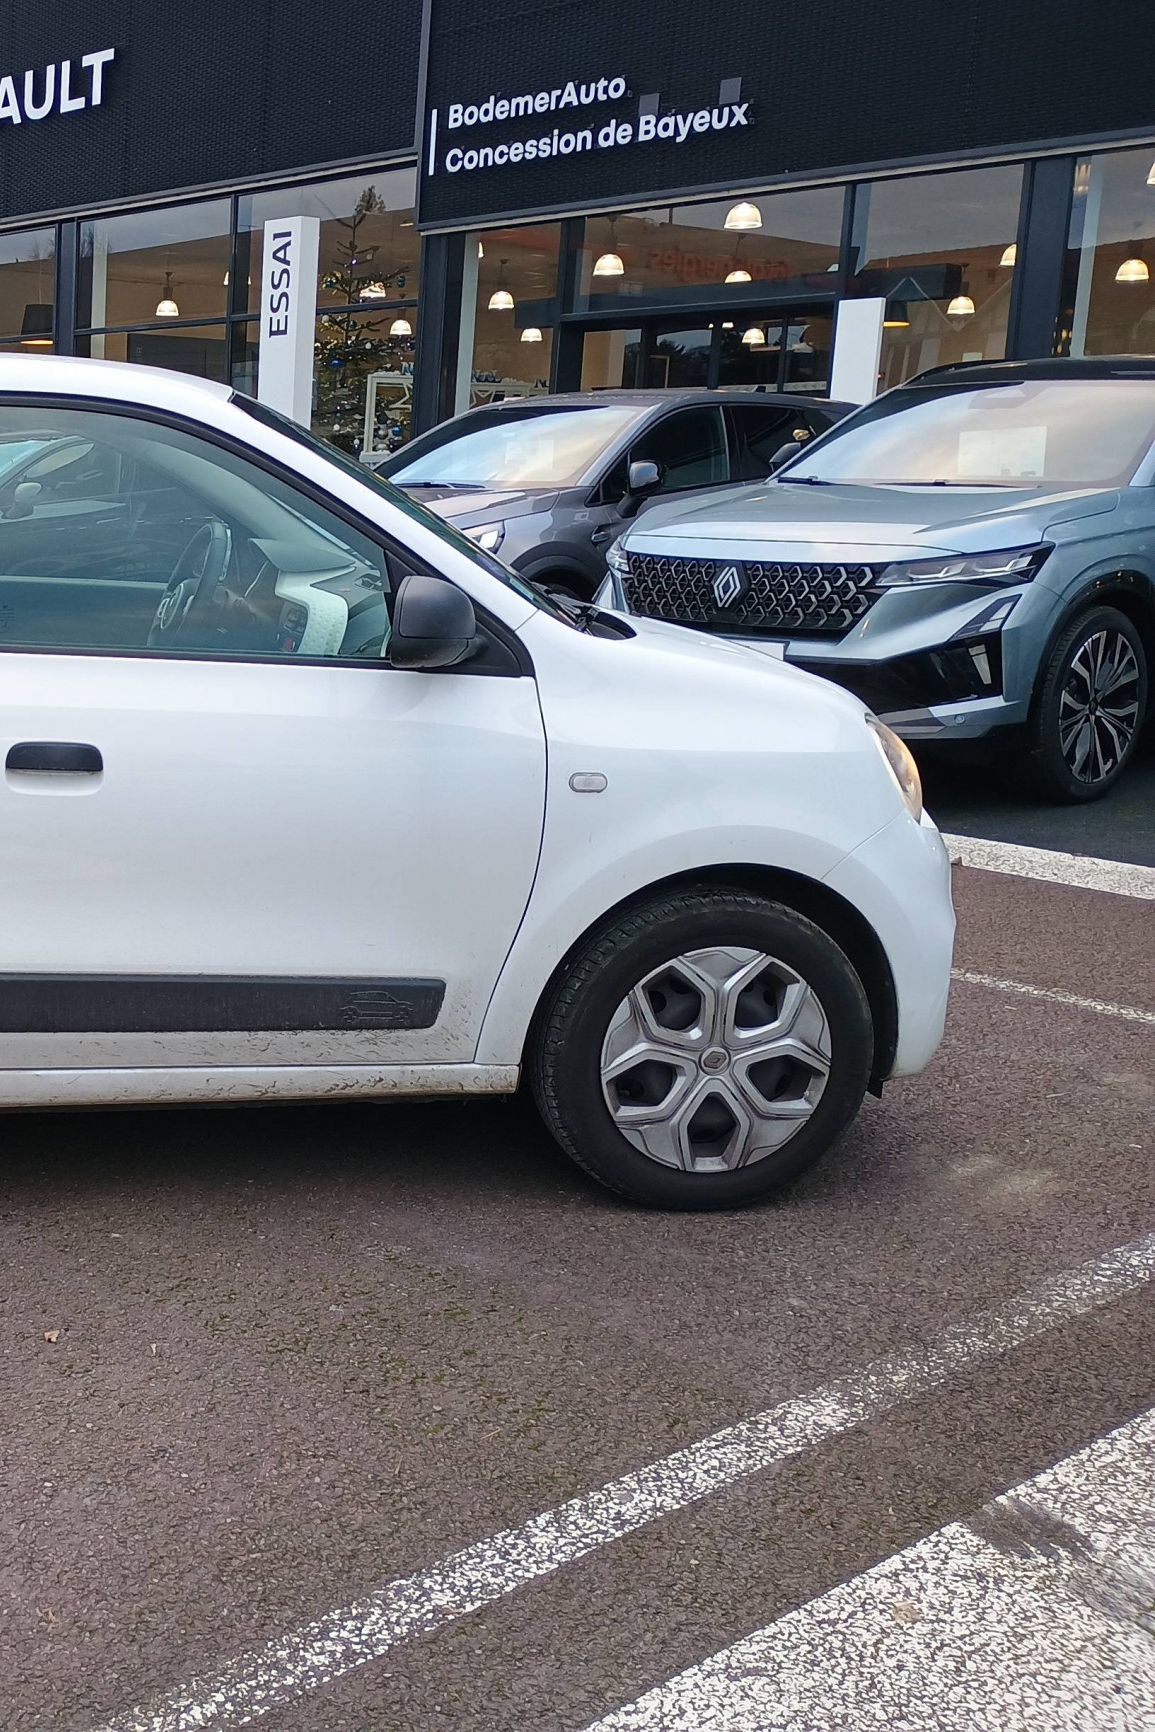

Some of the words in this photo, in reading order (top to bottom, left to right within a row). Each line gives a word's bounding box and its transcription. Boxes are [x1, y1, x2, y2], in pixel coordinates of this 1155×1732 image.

[448, 77, 626, 128] BodemerAuto
[445, 128, 592, 172] Concession
[598, 119, 633, 148] de
[638, 103, 749, 142] Bayeux
[269, 231, 292, 338] ESSAI
